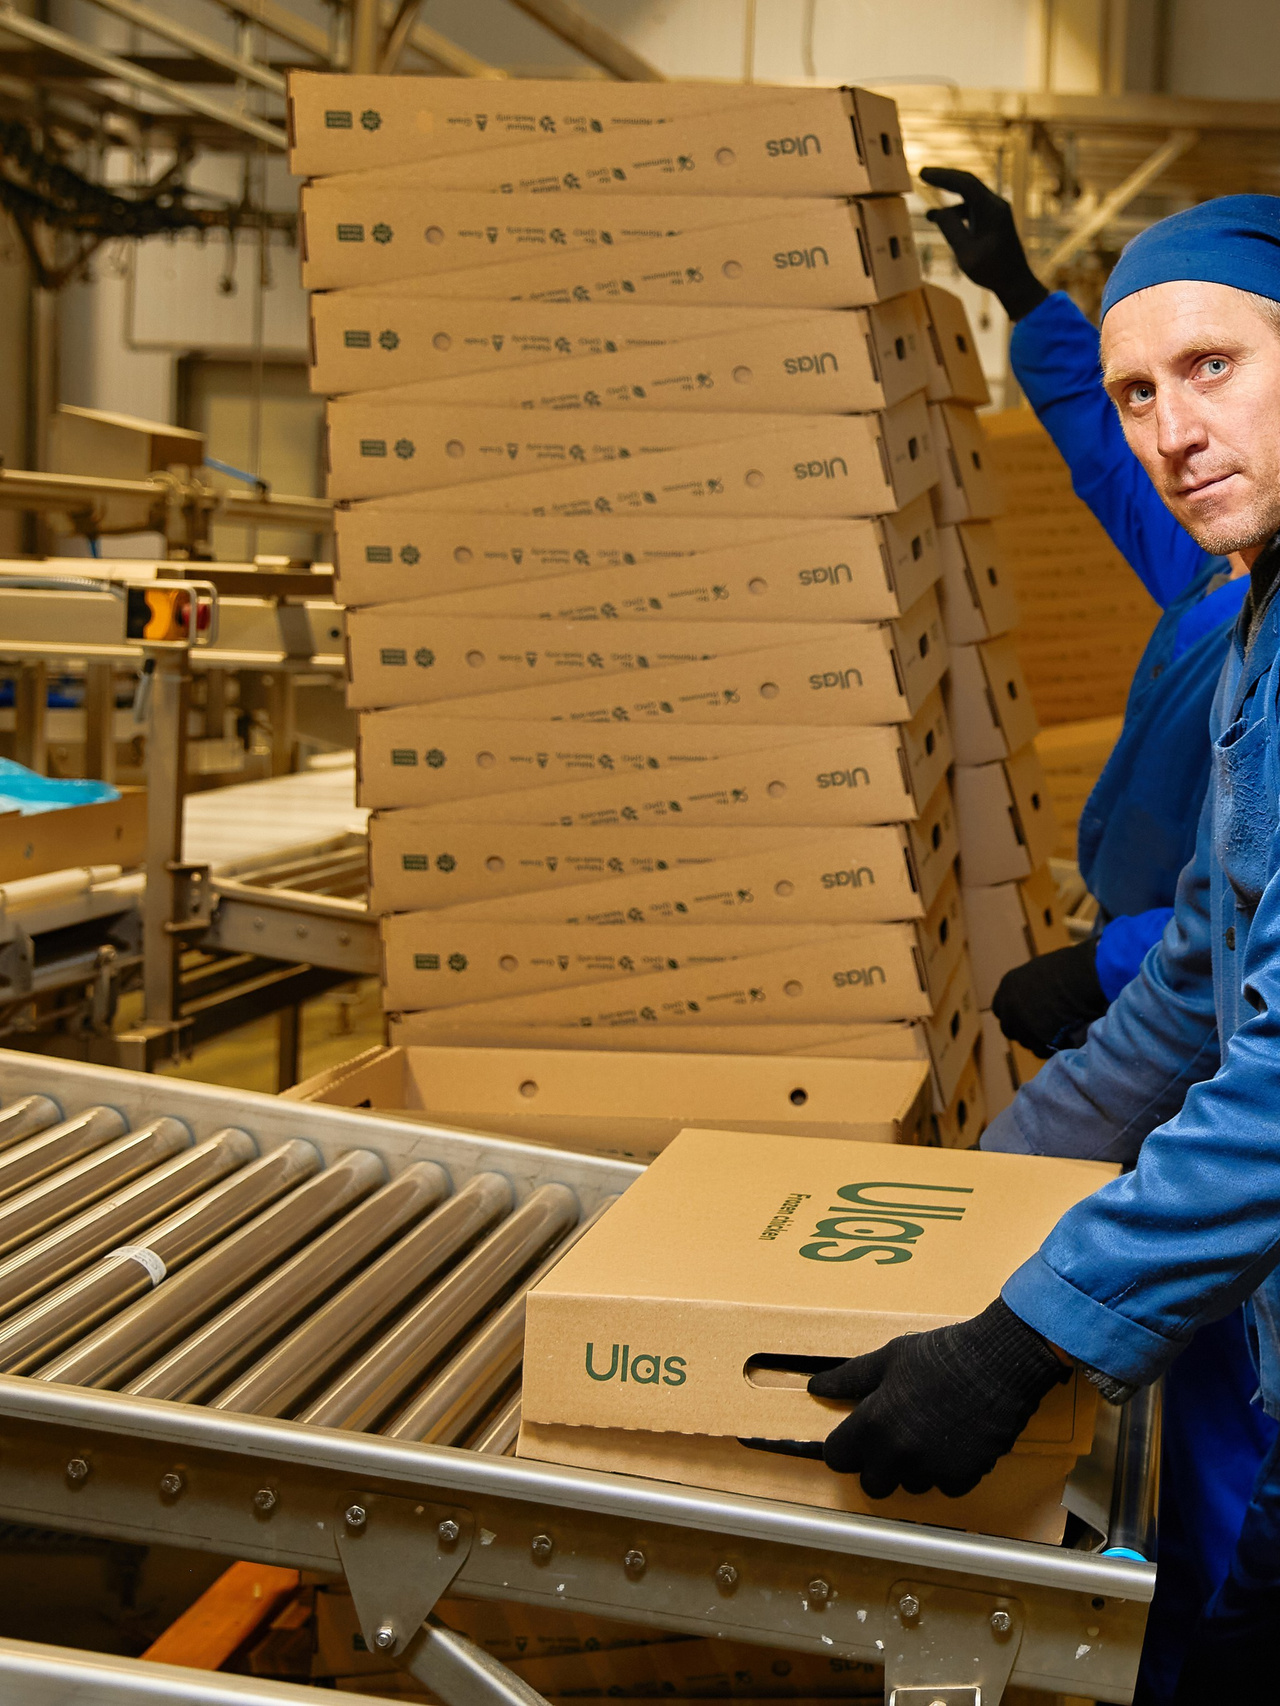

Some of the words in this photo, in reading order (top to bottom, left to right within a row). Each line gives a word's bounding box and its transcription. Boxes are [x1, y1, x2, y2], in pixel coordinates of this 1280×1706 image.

[765, 133, 822, 157] Ulas
[773, 246, 829, 269] Ulas
[783, 352, 839, 375] Ulas
[793, 456, 848, 480] Ulas
[797, 563, 853, 586] Ulas
[808, 668, 863, 690] Ulas
[815, 767, 870, 789] Ulas
[820, 866, 875, 889] Ulas
[832, 965, 886, 988] Ulas
[777, 1193, 811, 1214] Frozen
[758, 1216, 794, 1240] chicken
[800, 1183, 973, 1265] Ulas
[586, 1342, 687, 1387] Ulas
